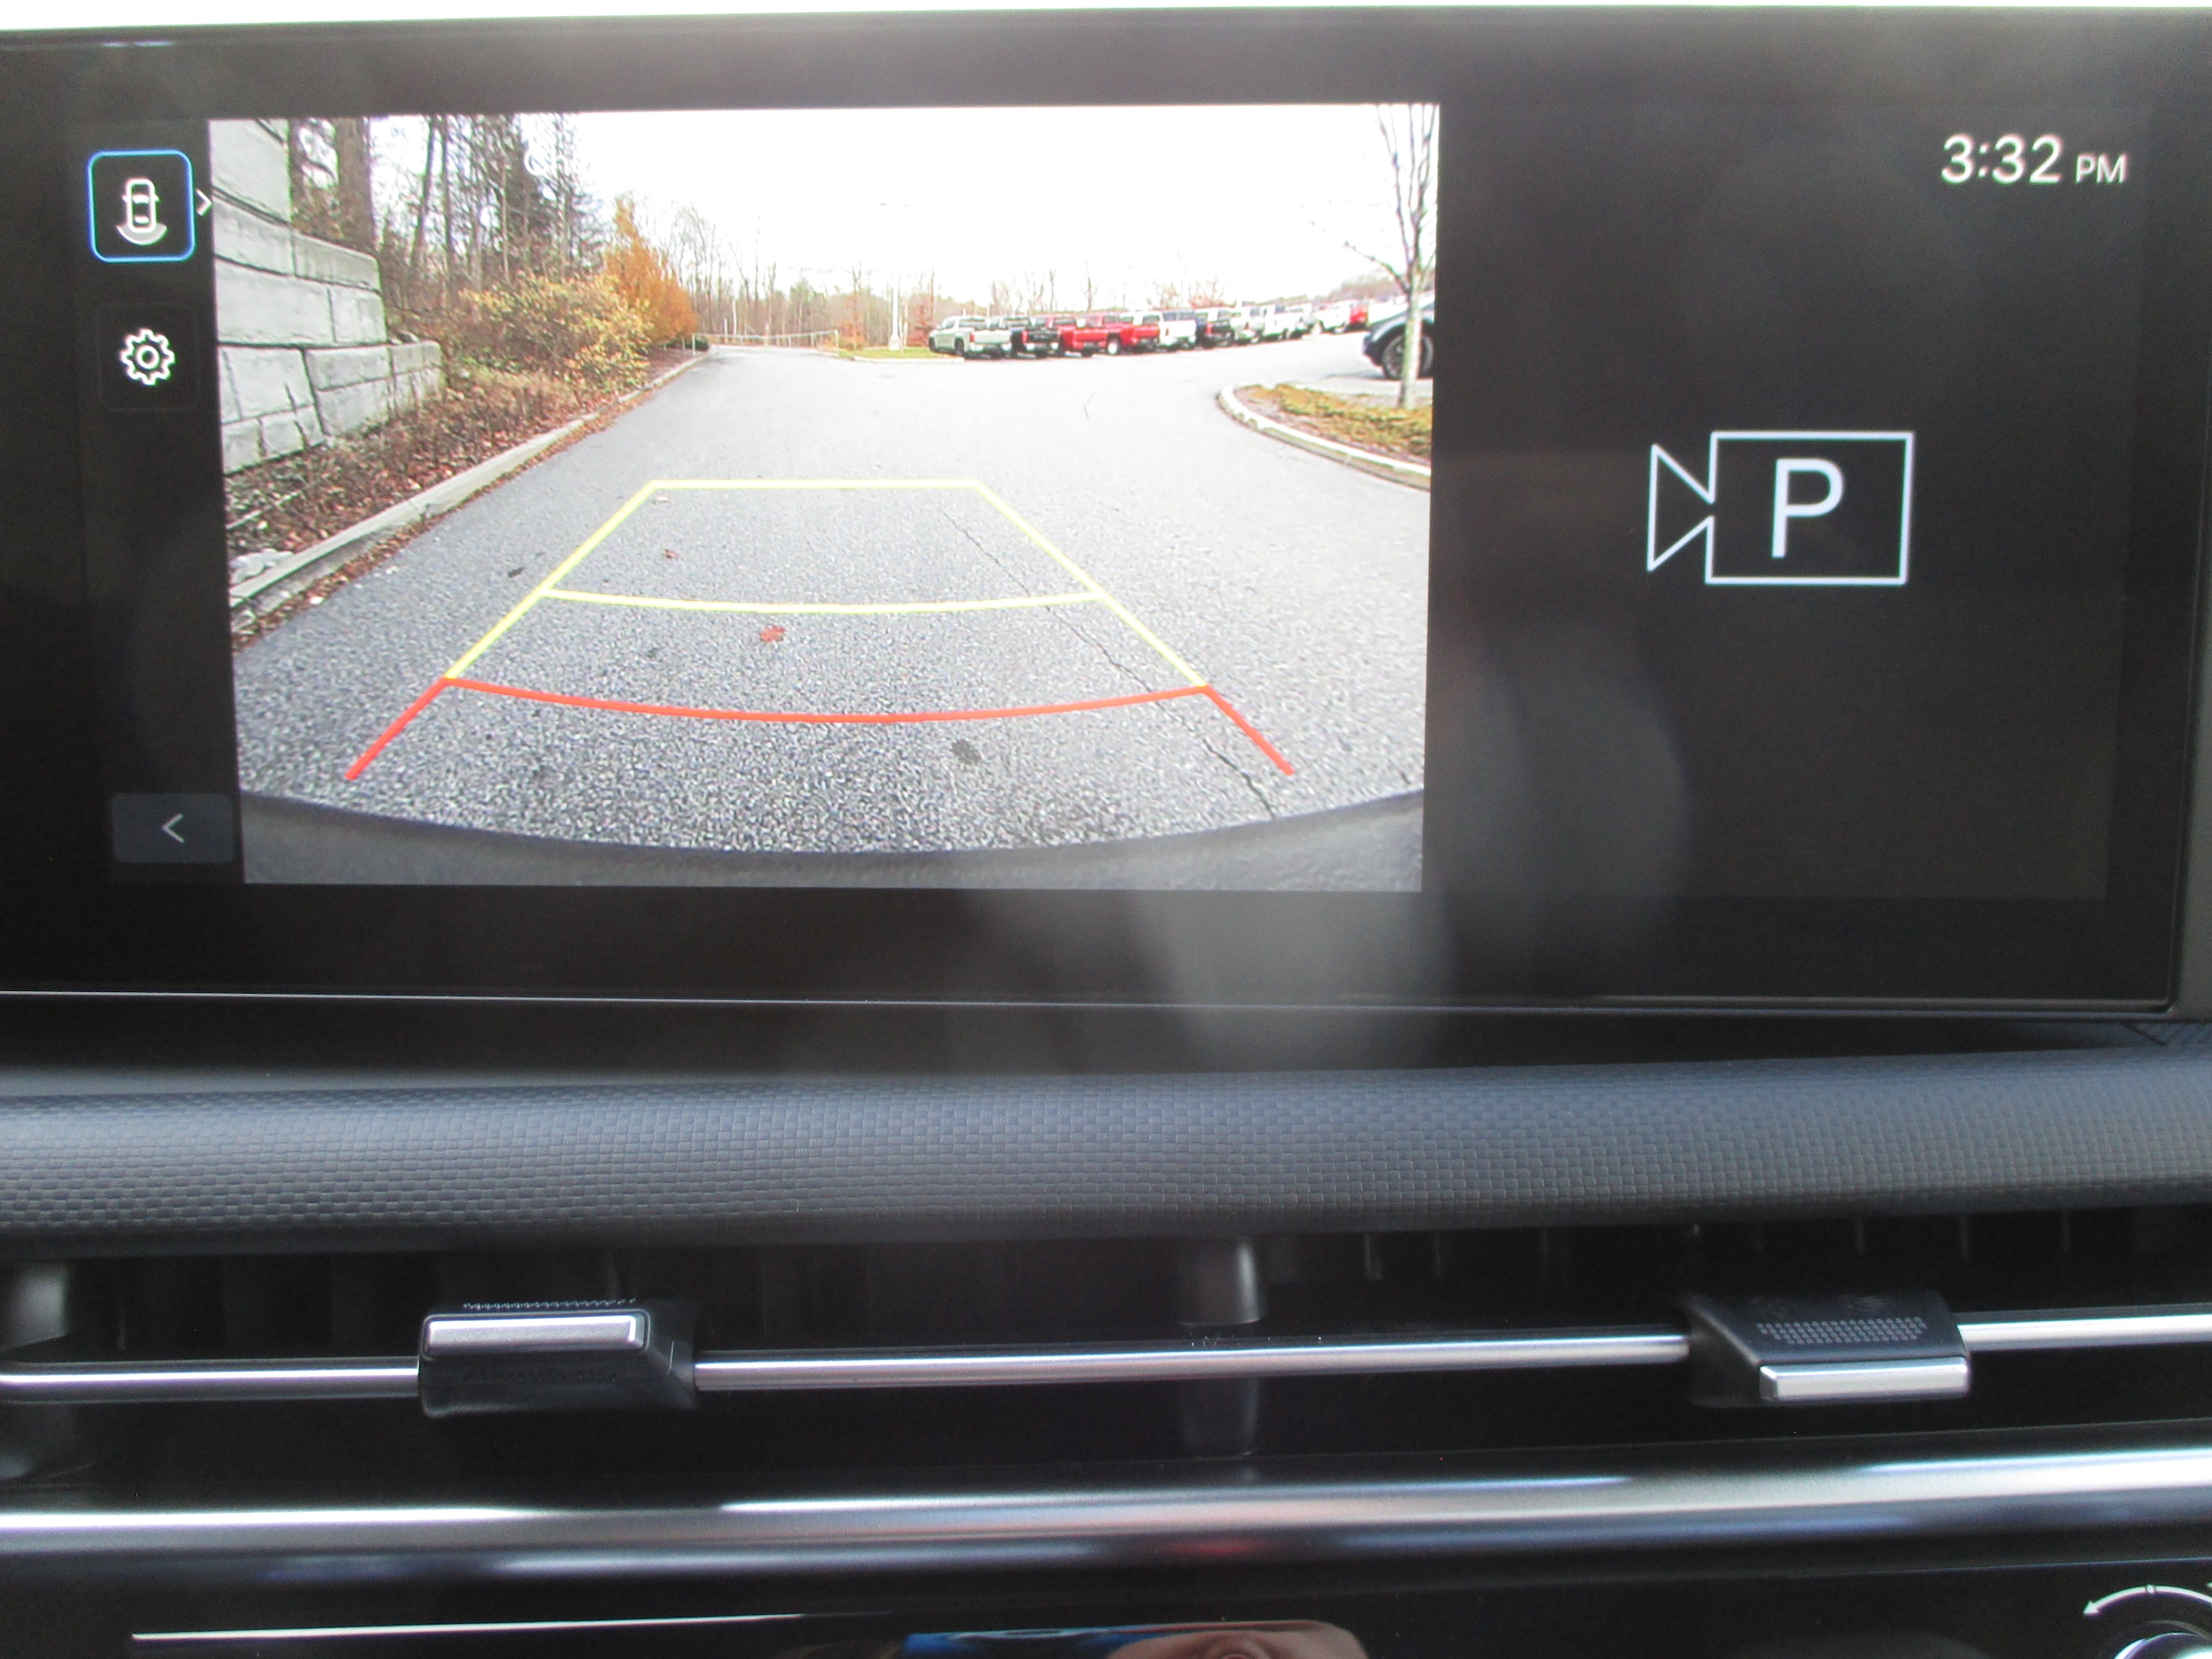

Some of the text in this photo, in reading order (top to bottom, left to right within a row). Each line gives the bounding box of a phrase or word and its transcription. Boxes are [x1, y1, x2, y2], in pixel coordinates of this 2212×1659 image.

[1940, 133, 2128, 184] 3:32 PM
[1771, 457, 1845, 558] P
